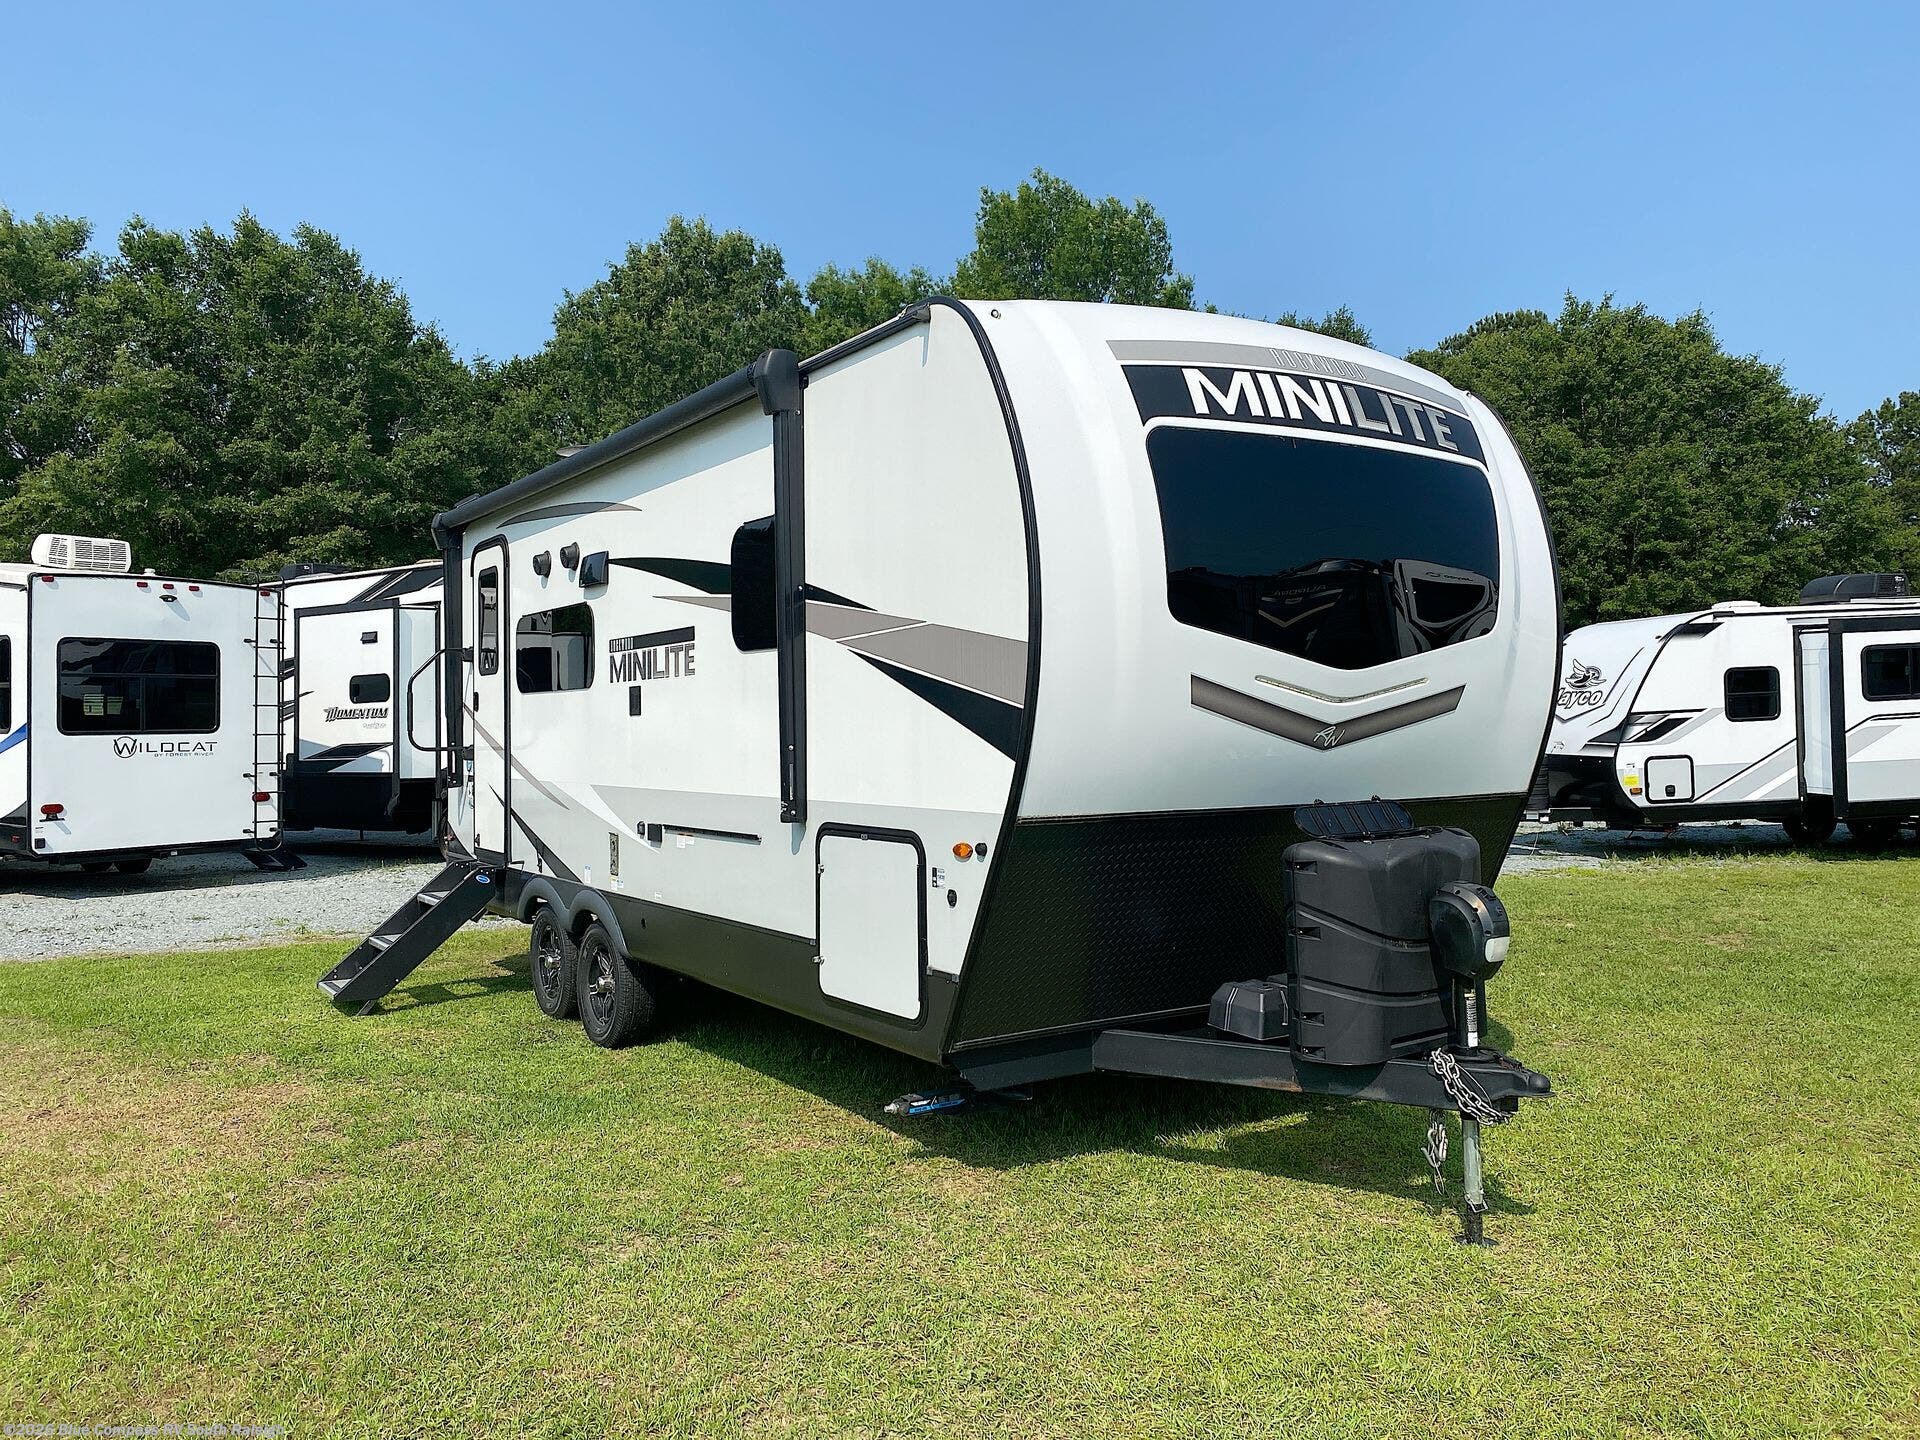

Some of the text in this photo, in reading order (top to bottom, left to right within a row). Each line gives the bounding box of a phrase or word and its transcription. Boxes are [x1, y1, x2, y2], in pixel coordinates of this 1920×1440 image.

[1269, 348, 1367, 381] ROCKWOOD
[1181, 368, 1459, 452] MINILITE
[609, 642, 695, 683] MINILITE
[113, 738, 218, 757] WILDCAT
